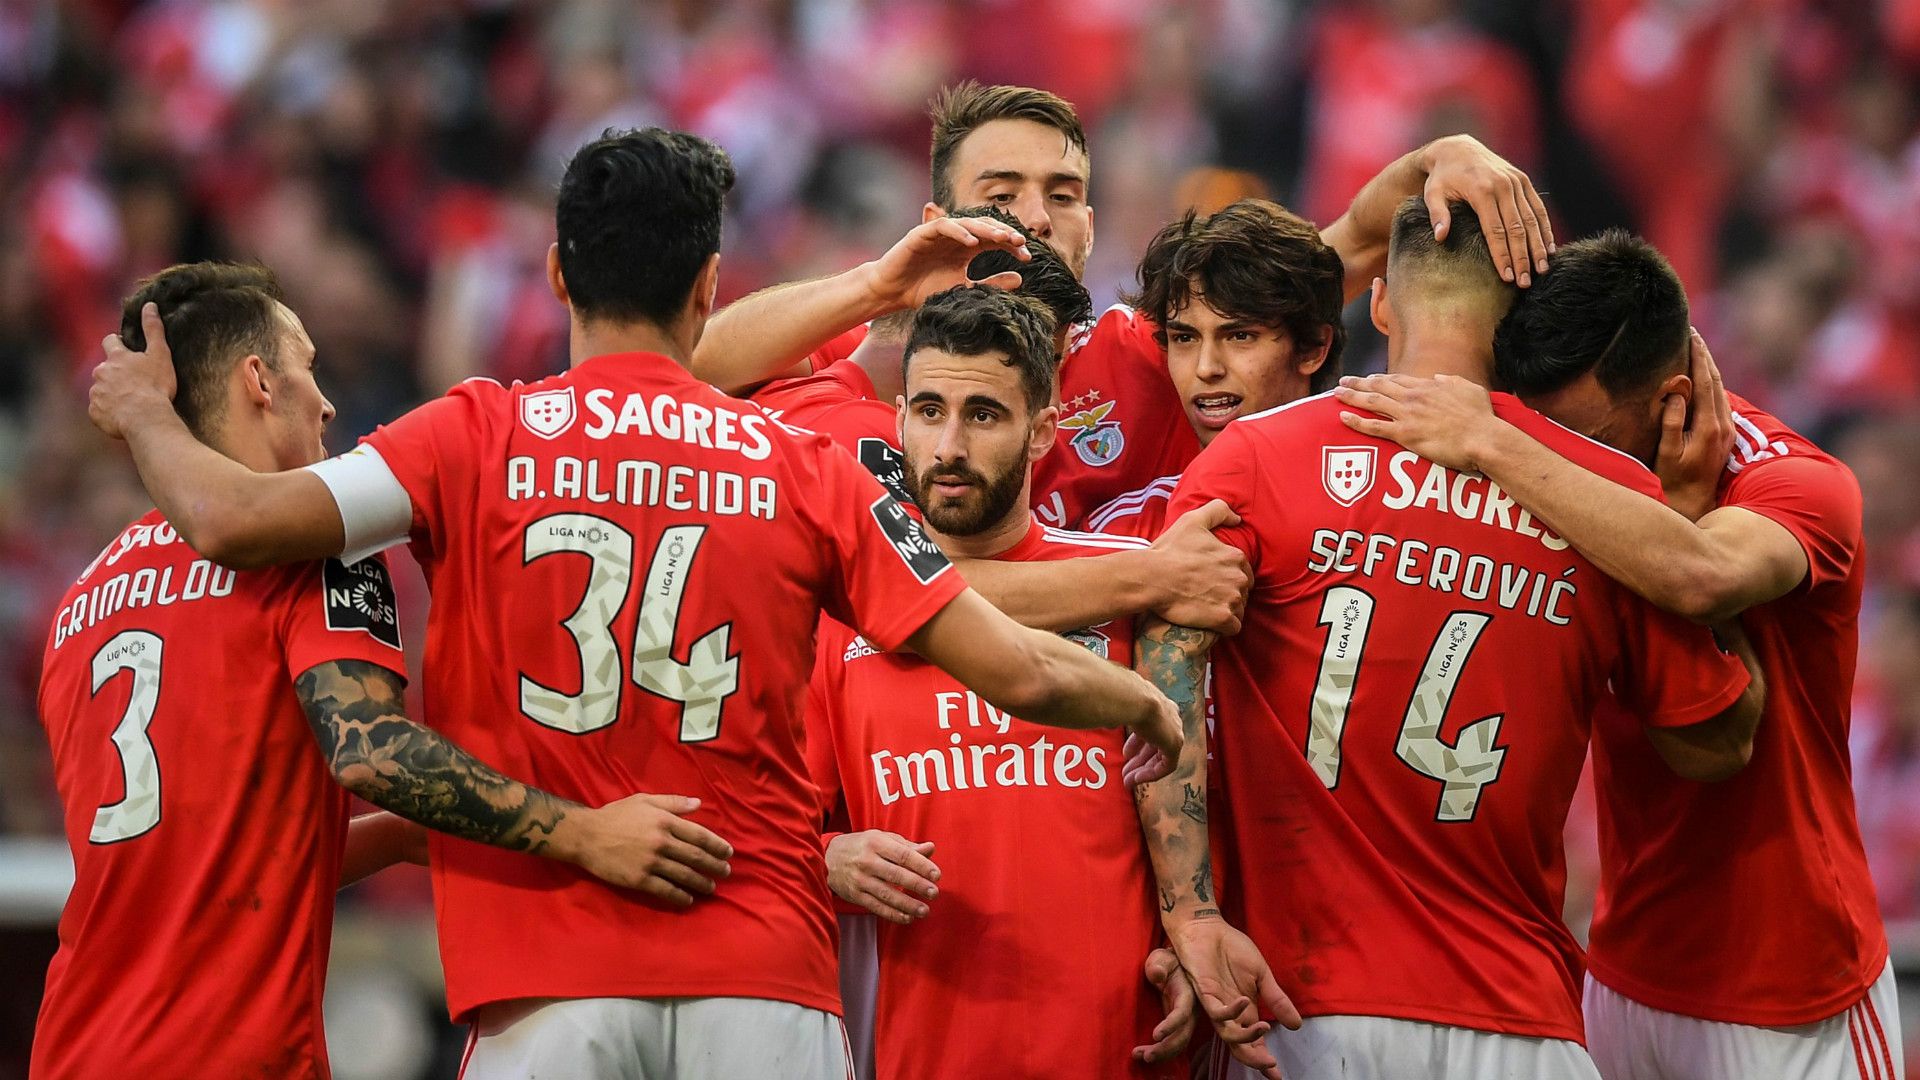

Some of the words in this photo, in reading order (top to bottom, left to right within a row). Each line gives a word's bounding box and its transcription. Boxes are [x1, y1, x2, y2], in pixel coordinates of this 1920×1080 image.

[583, 388, 772, 460] SAGRES
[106, 521, 185, 566] SAG
[549, 527, 575, 538] LIGA
[53, 559, 237, 650] GRIMALDO
[661, 570, 675, 596] LIGA
[1307, 528, 1578, 626] SEFEROVIĆ
[107, 650, 120, 662] LIG
[518, 511, 741, 743] 34
[1336, 633, 1350, 659] LIGA
[1437, 653, 1455, 678] LIGA
[935, 690, 1011, 734] Fly
[1304, 585, 1509, 822] 14
[89, 629, 164, 844] 3
[870, 733, 1107, 805] Emirates
